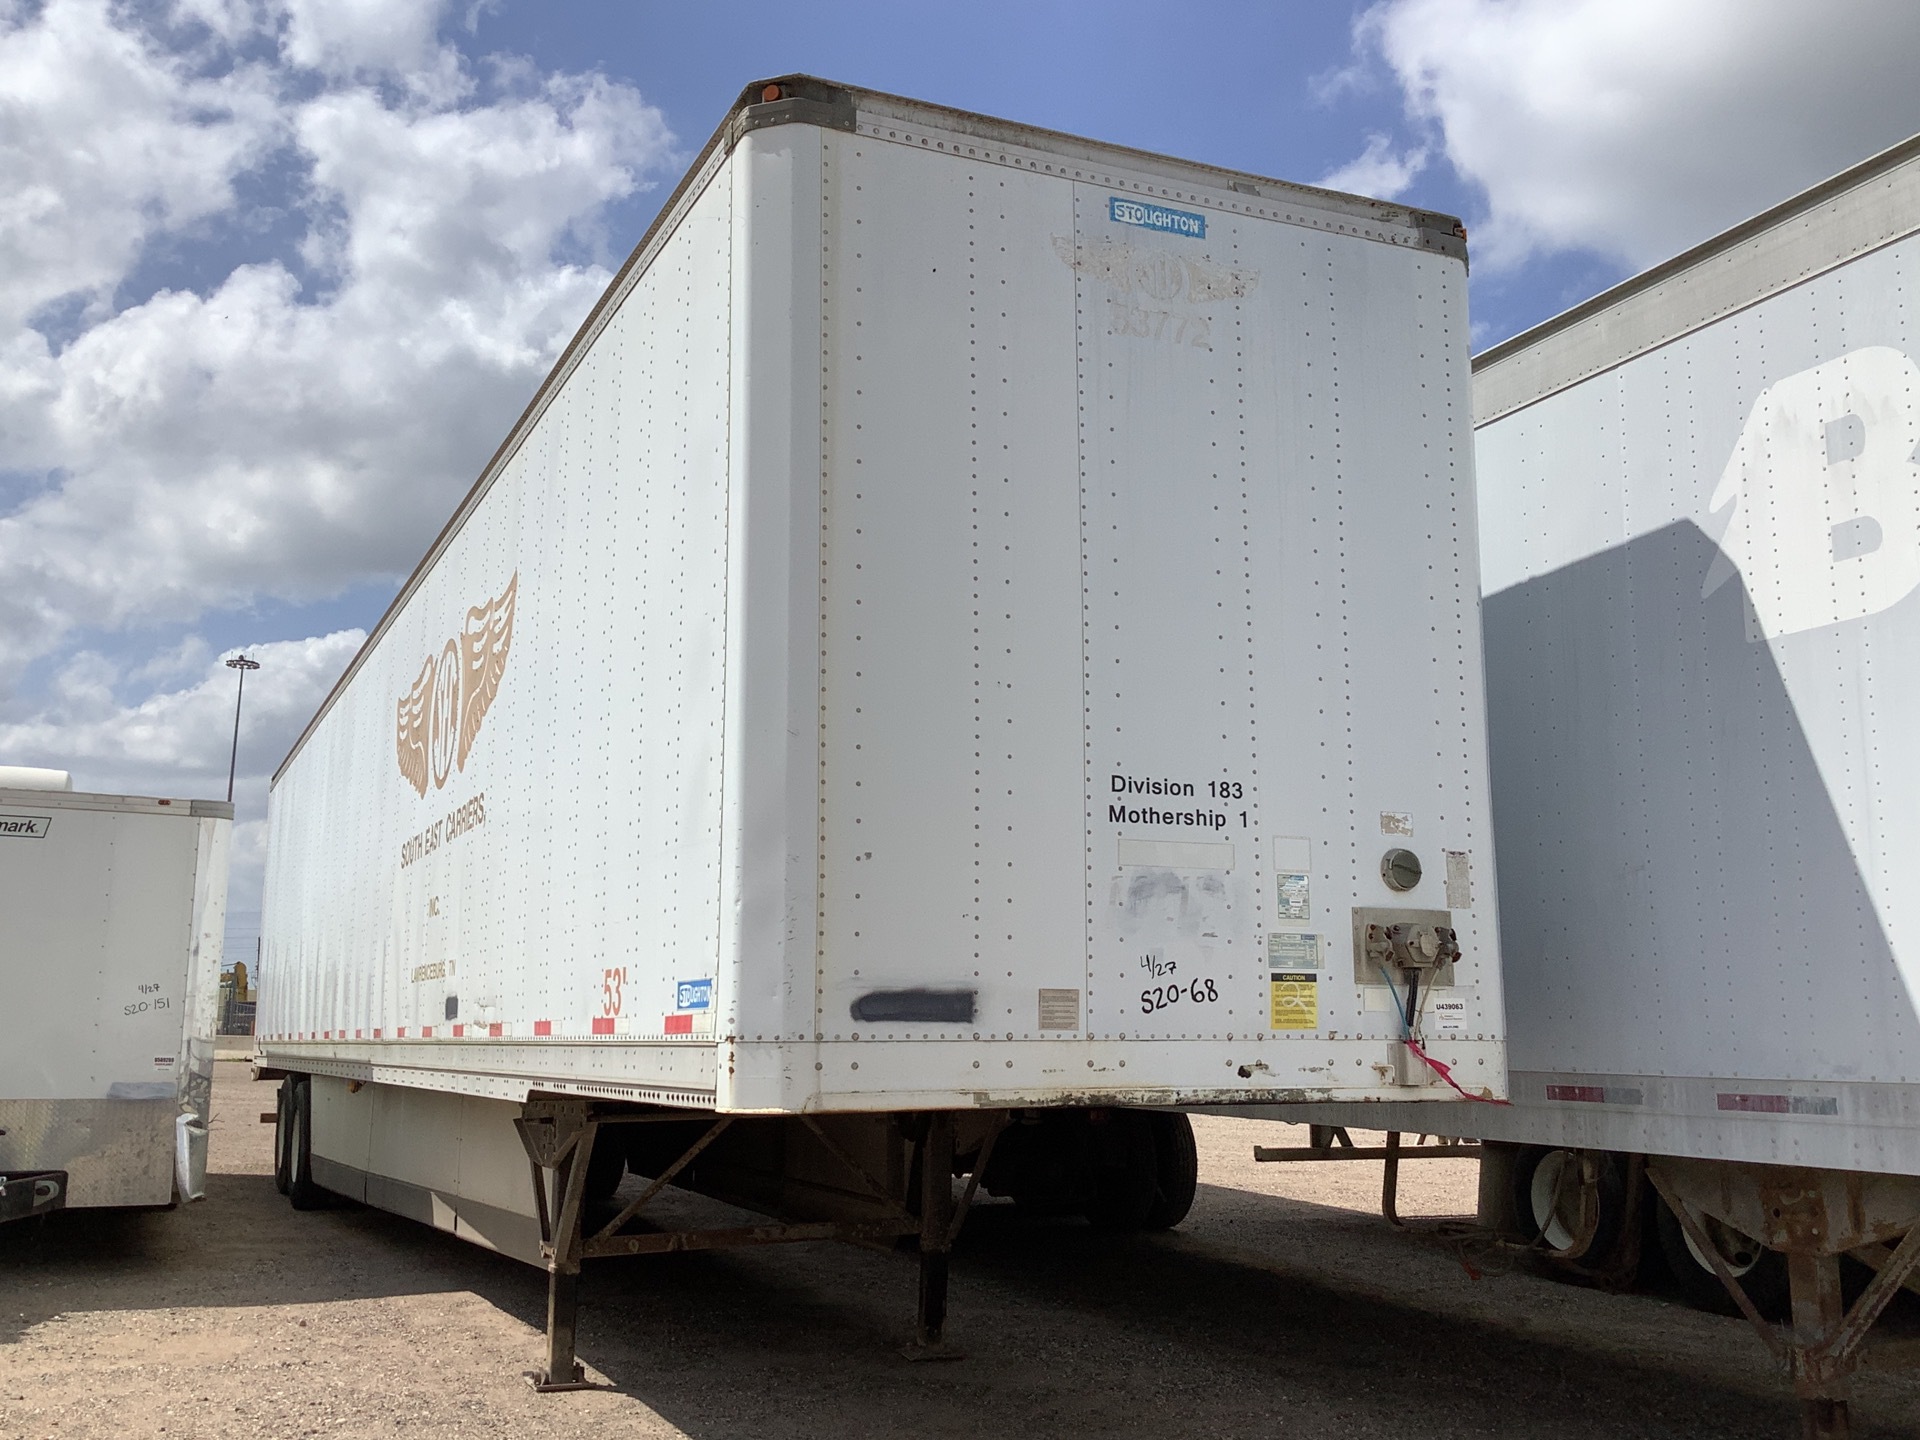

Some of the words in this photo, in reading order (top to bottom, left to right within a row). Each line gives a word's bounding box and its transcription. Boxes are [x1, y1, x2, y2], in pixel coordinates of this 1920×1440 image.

[1114, 203, 1200, 234] STOUGHTON
[1111, 774, 1195, 797] Division
[1207, 780, 1244, 799] 183
[1108, 804, 1227, 831] Mothership
[1239, 810, 1248, 828] 1
[401, 832, 423, 869] SOUTH
[425, 818, 443, 855] EAST
[1139, 954, 1177, 979] 4/27
[1140, 977, 1219, 1014] S20-68
